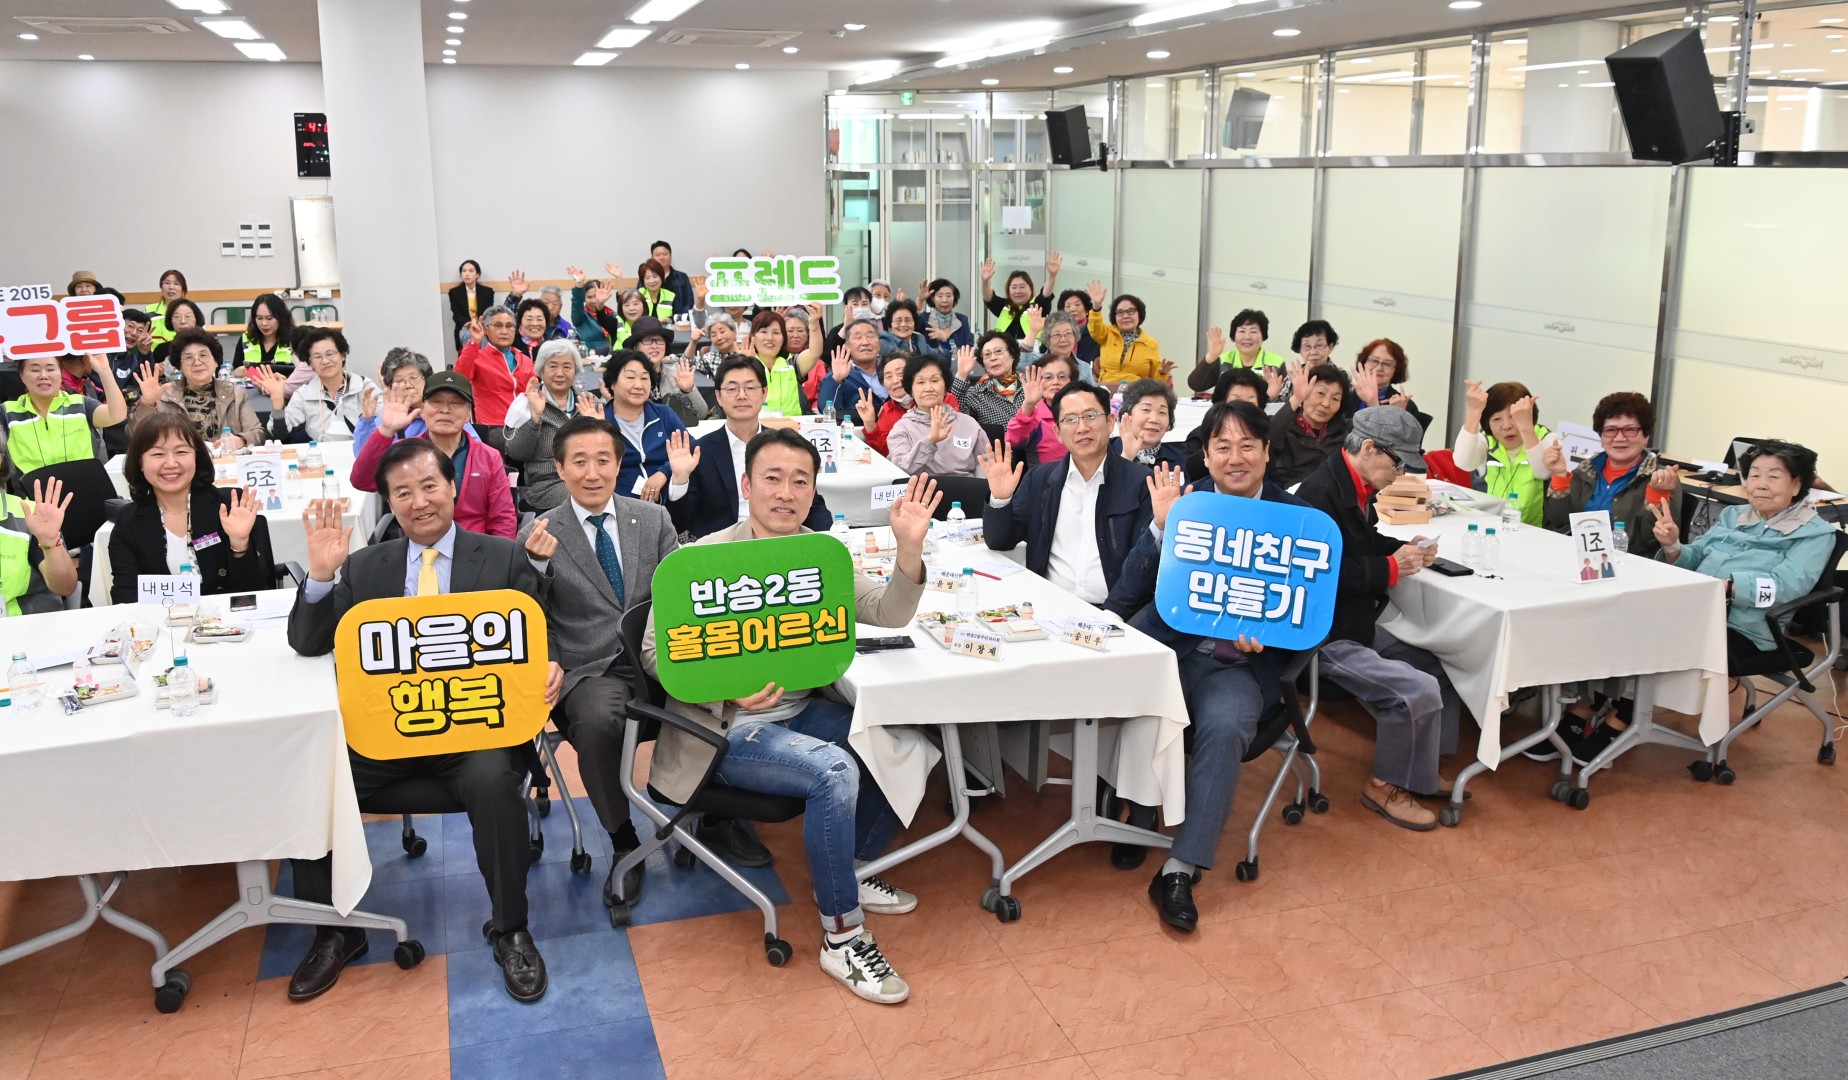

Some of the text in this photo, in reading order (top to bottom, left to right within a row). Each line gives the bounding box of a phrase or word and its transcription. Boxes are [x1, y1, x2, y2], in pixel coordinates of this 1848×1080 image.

[10, 286, 50, 301] 2015
[0, 299, 120, 355] 그룹
[246, 470, 276, 487] 5조
[1173, 519, 1331, 581] 동네친구
[1581, 532, 1605, 552] 1조
[142, 581, 193, 597] 내빈석
[690, 567, 823, 617] 반송2동
[1188, 570, 1306, 627] 만들기
[1759, 585, 1772, 602] 1조
[359, 608, 528, 674] 마을의
[666, 605, 849, 663] 홀몸어르신
[389, 673, 504, 737] 행복
